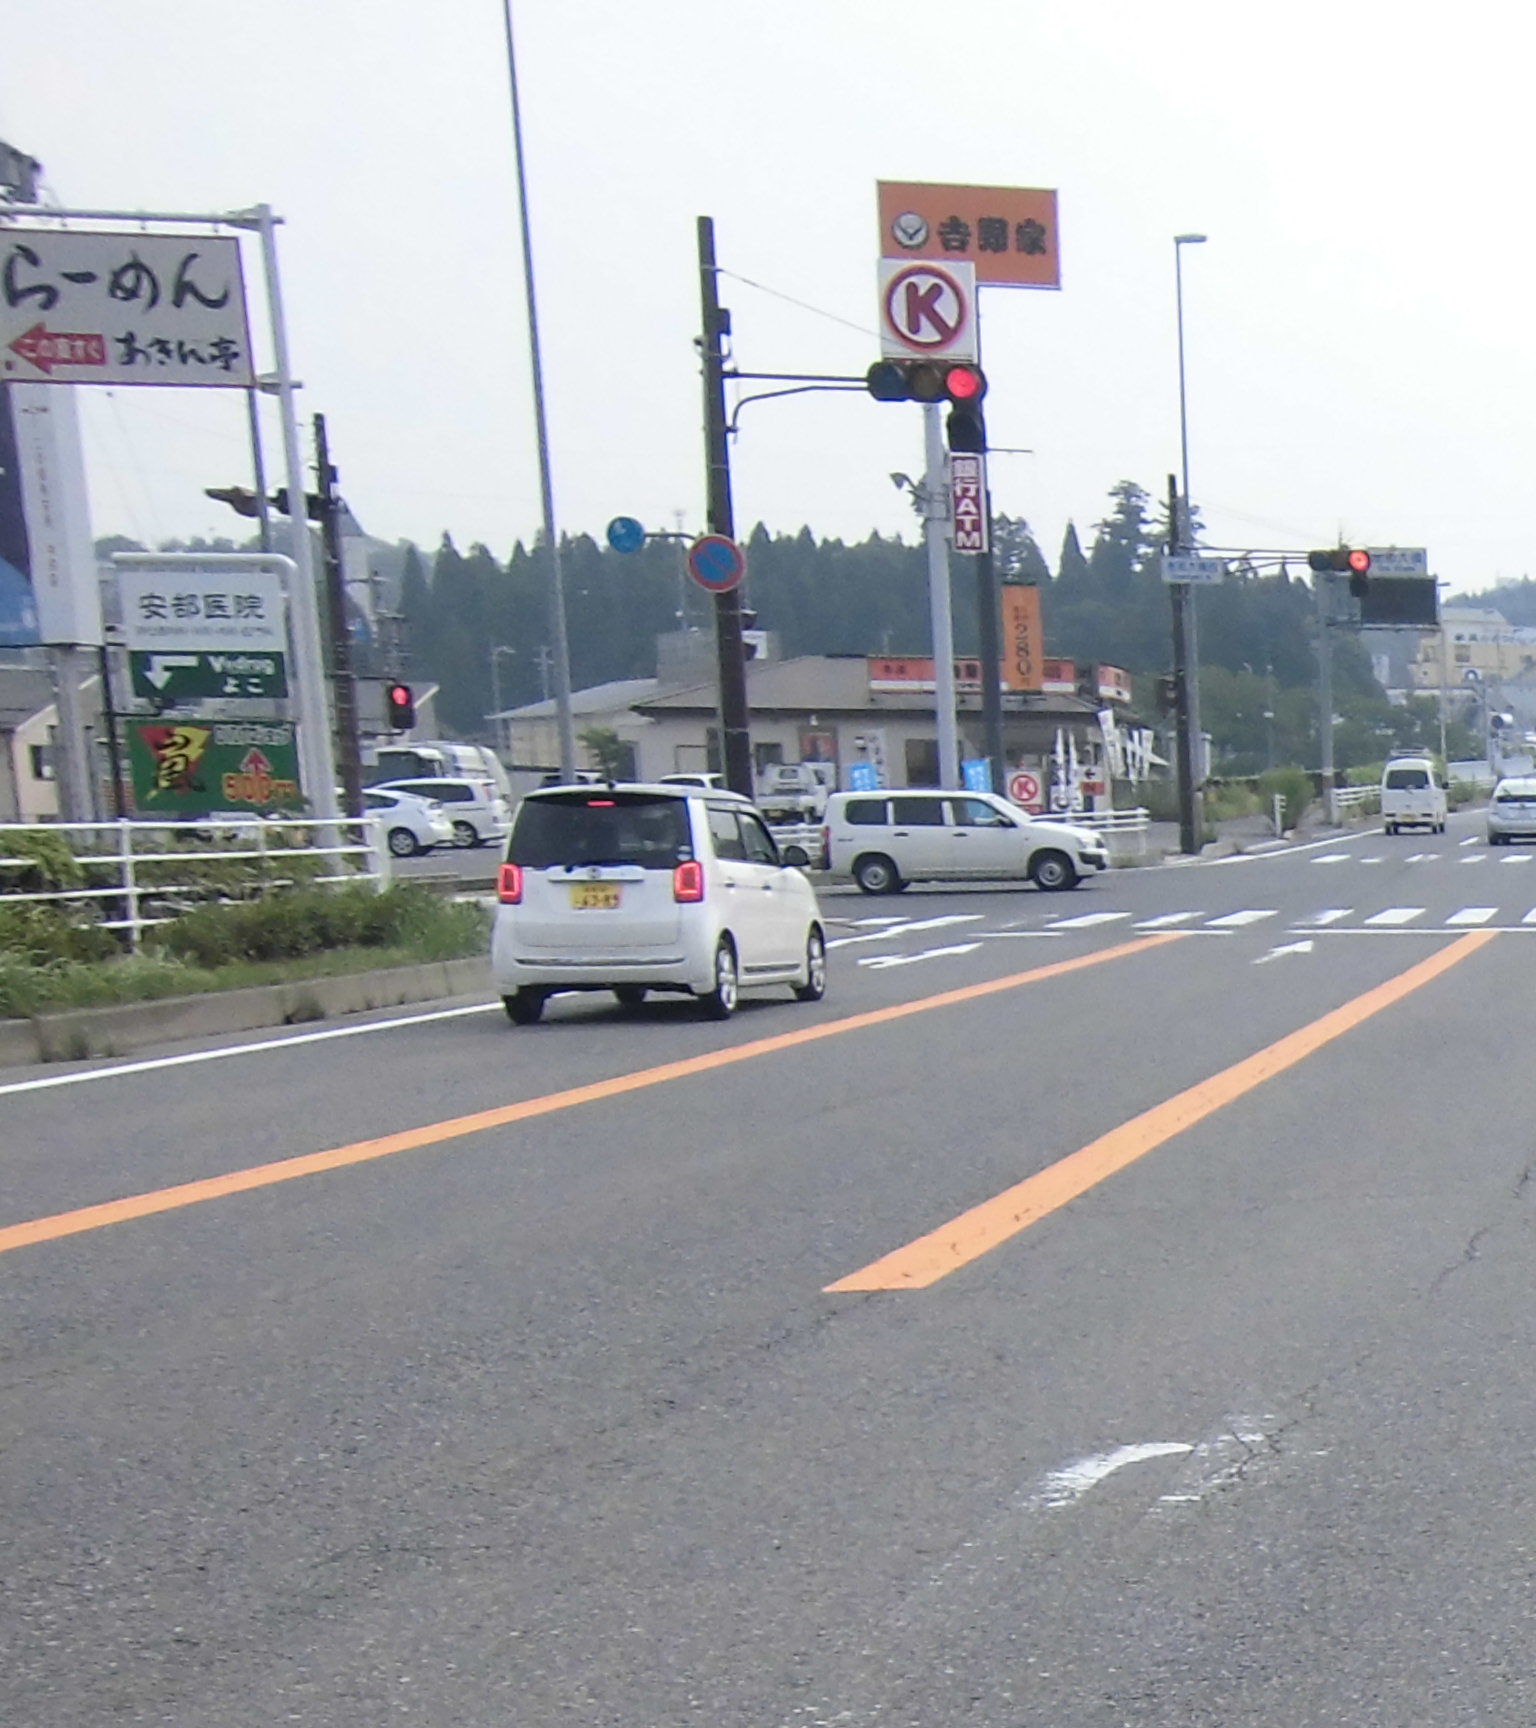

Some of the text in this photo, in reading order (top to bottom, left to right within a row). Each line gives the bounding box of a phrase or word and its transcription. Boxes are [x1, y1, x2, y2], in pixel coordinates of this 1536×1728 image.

[3, 243, 230, 314] らーめん
[902, 277, 962, 347] K
[139, 592, 265, 620] 安部医院
